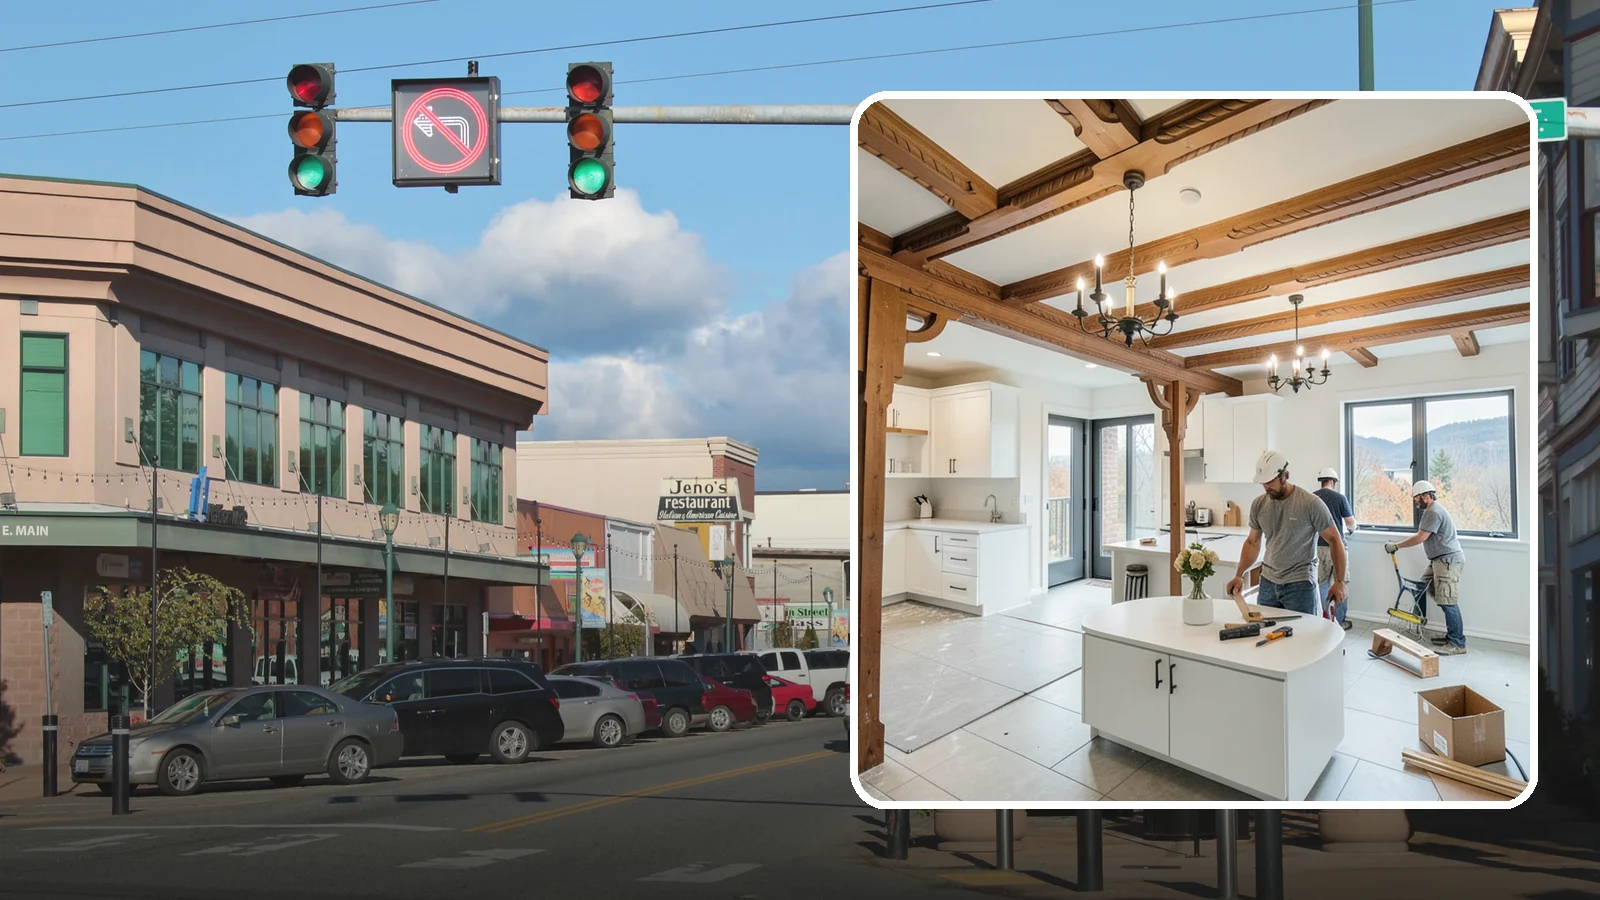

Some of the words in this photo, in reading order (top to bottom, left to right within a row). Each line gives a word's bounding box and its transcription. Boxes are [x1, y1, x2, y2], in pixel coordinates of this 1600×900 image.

[669, 479, 728, 495] Jeno's
[665, 496, 731, 509] restaurant
[658, 510, 682, 519] Italian
[686, 510, 714, 519] American
[715, 510, 737, 519] Cuisine
[2, 525, 13, 536] E.
[15, 525, 49, 536] MAIN
[797, 607, 828, 616] Street
[791, 619, 823, 627] lass
